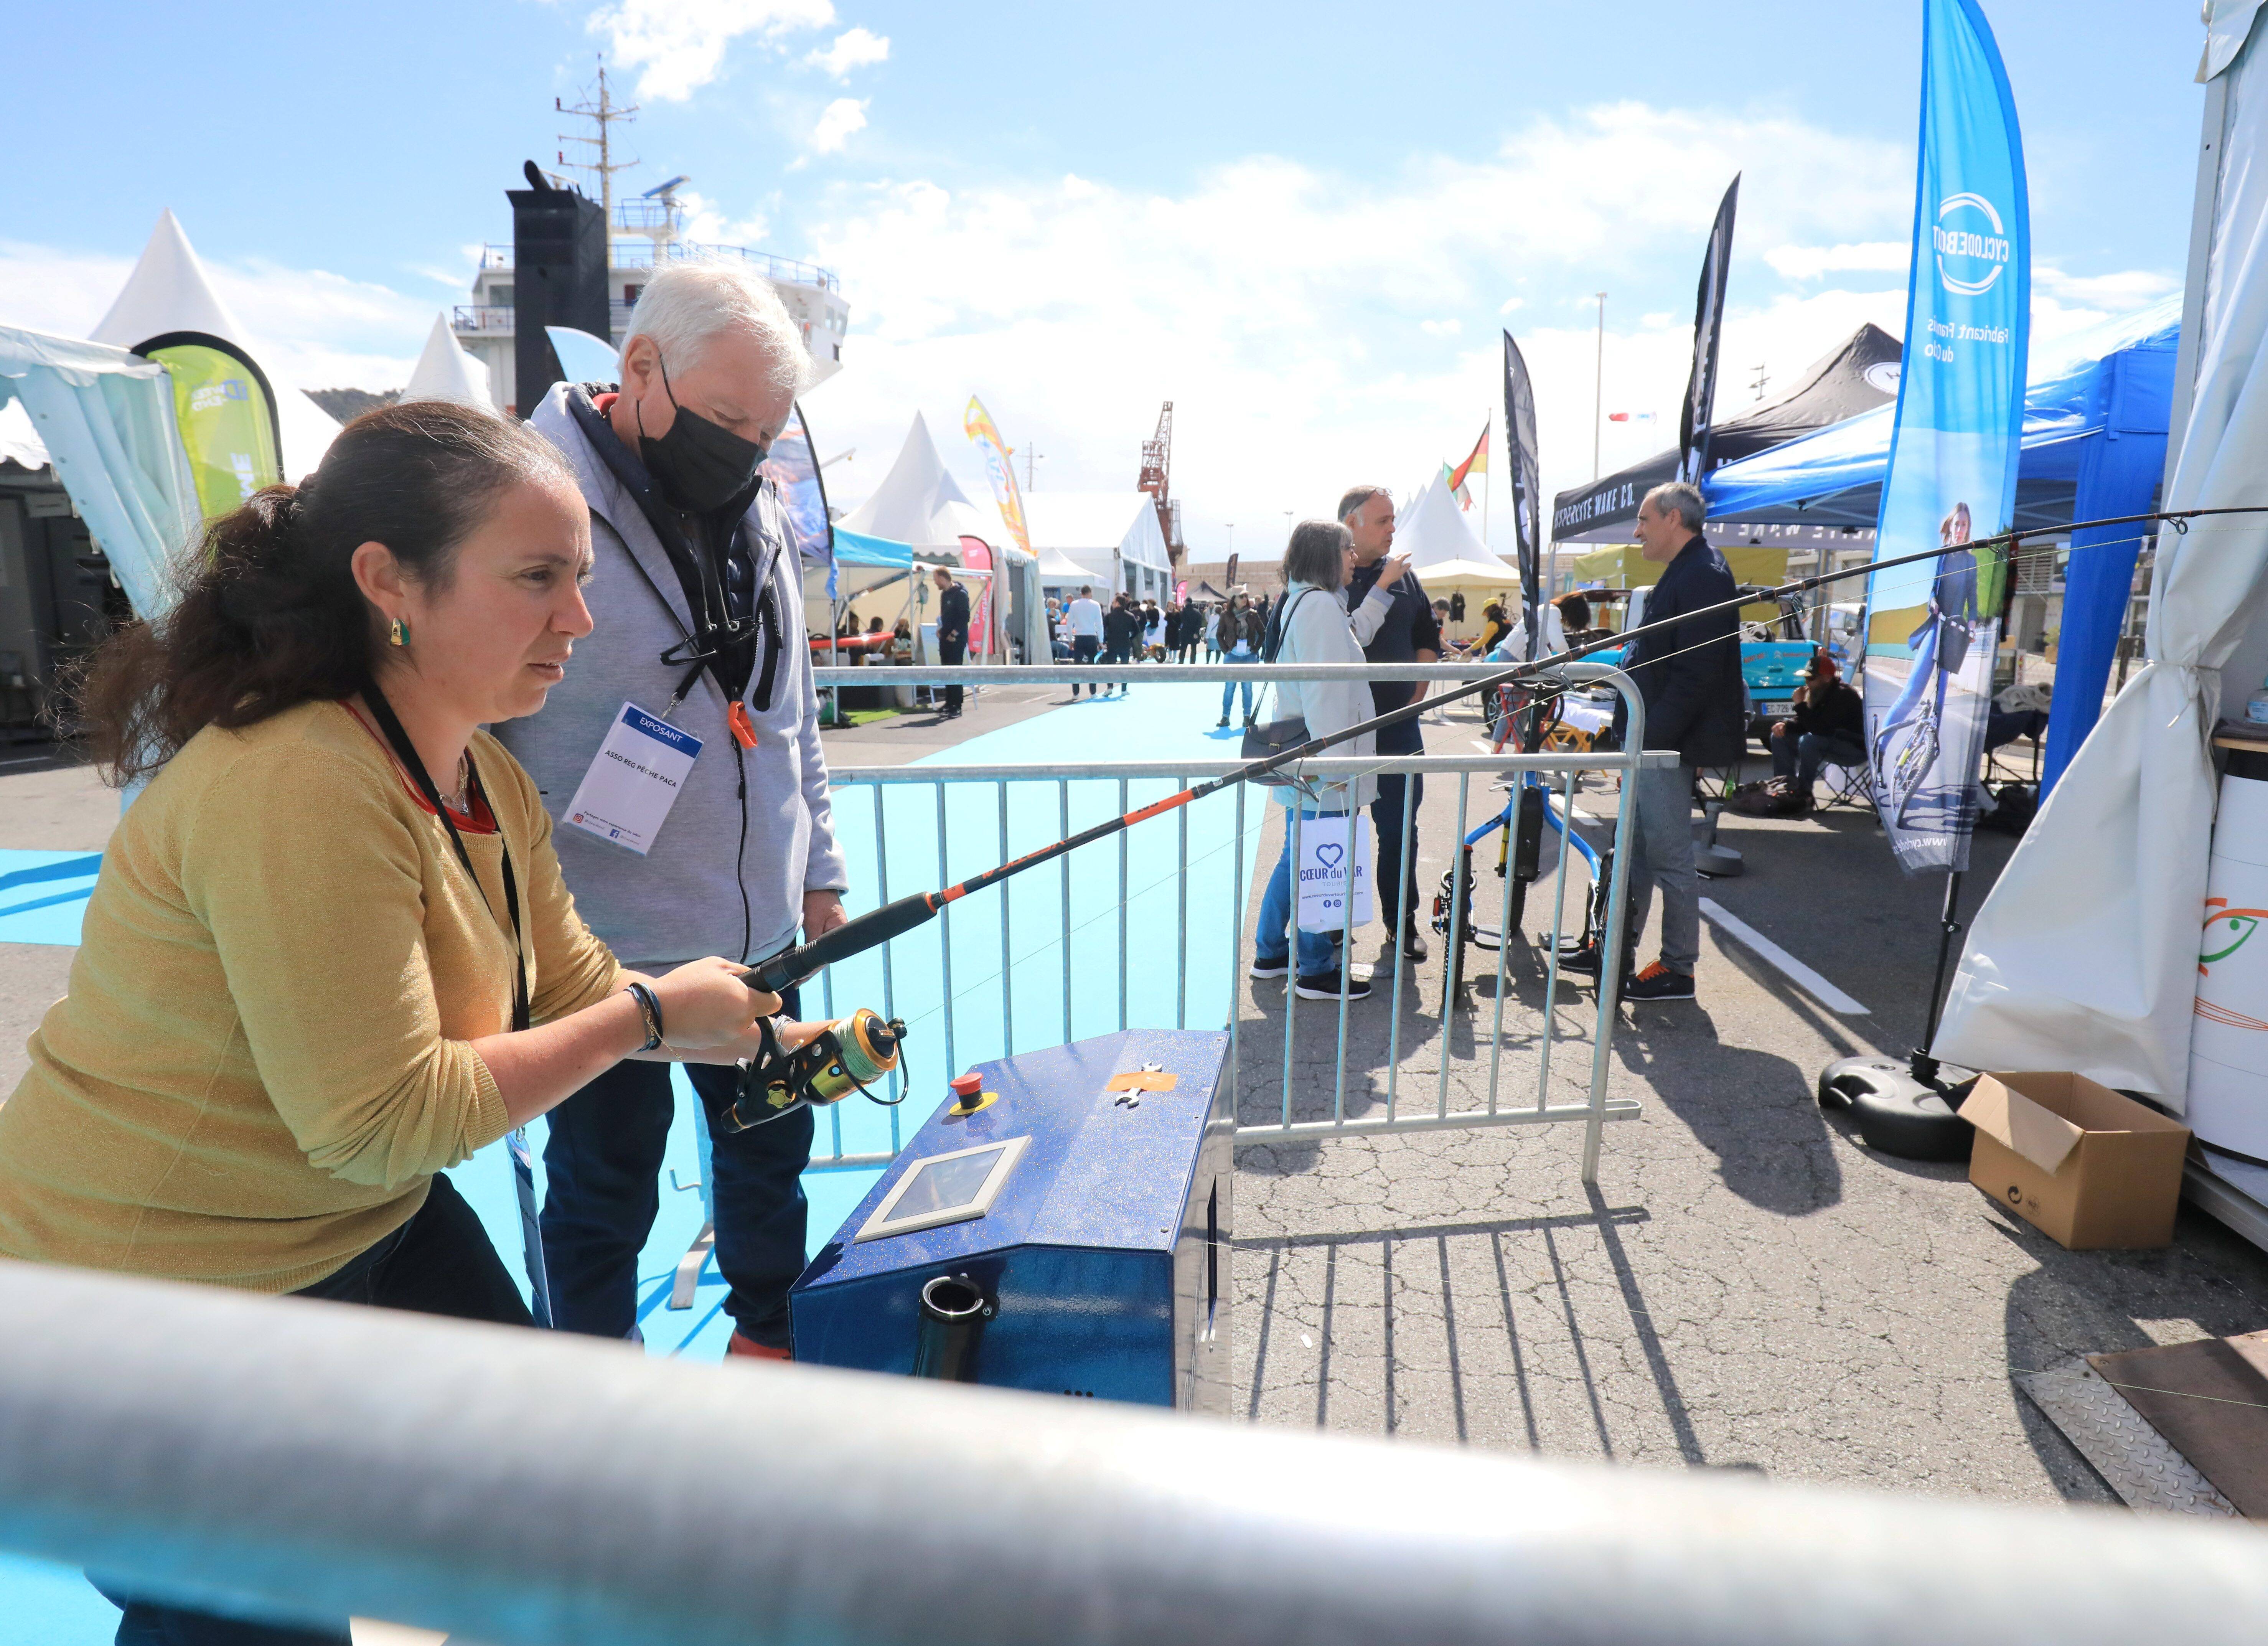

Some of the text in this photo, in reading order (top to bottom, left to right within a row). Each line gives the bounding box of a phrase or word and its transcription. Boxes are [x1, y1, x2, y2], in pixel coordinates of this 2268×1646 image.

[1594, 488, 1617, 516] WAKE
[1620, 482, 1635, 509] CO.
[639, 717, 682, 742] EXPOSANT
[605, 750, 676, 787] ASSO REG PÊCHE PACA
[1300, 868, 1328, 881] CŒUR
[1331, 868, 1342, 879] du
